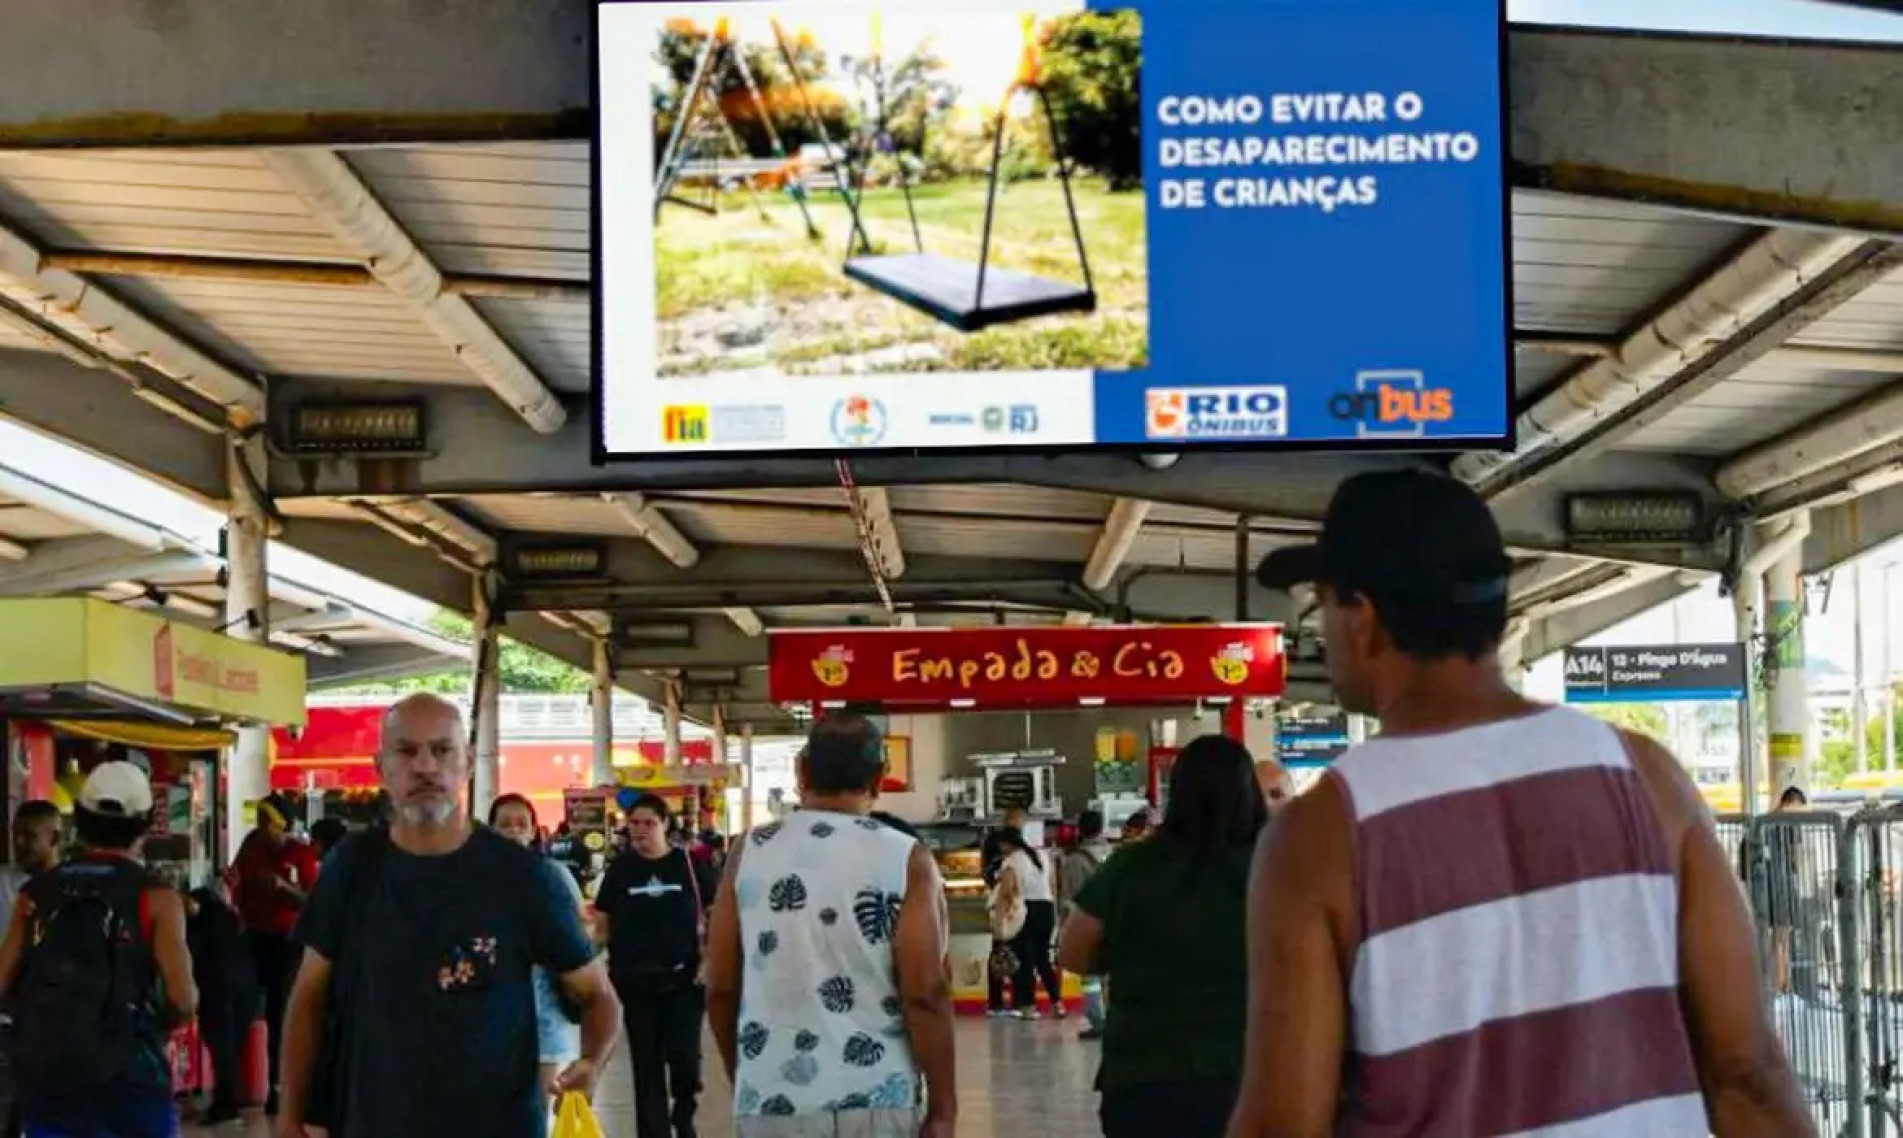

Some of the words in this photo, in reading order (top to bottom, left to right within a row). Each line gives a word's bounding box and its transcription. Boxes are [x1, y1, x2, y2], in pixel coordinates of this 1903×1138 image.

[1158, 95, 1262, 125] COMO
[1271, 92, 1386, 123] EVITAR
[1394, 91, 1422, 121] O
[1159, 132, 1478, 167] DESAPARECIMENTO
[1160, 180, 1205, 208] DE
[1213, 175, 1377, 213] CRIANÇAS
[1188, 393, 1280, 414] RIO
[1328, 384, 1453, 422] onbus
[892, 638, 1058, 688] Empada
[1071, 651, 1100, 678] &
[1113, 642, 1184, 679] Cia
[1566, 655, 1603, 674] A14
